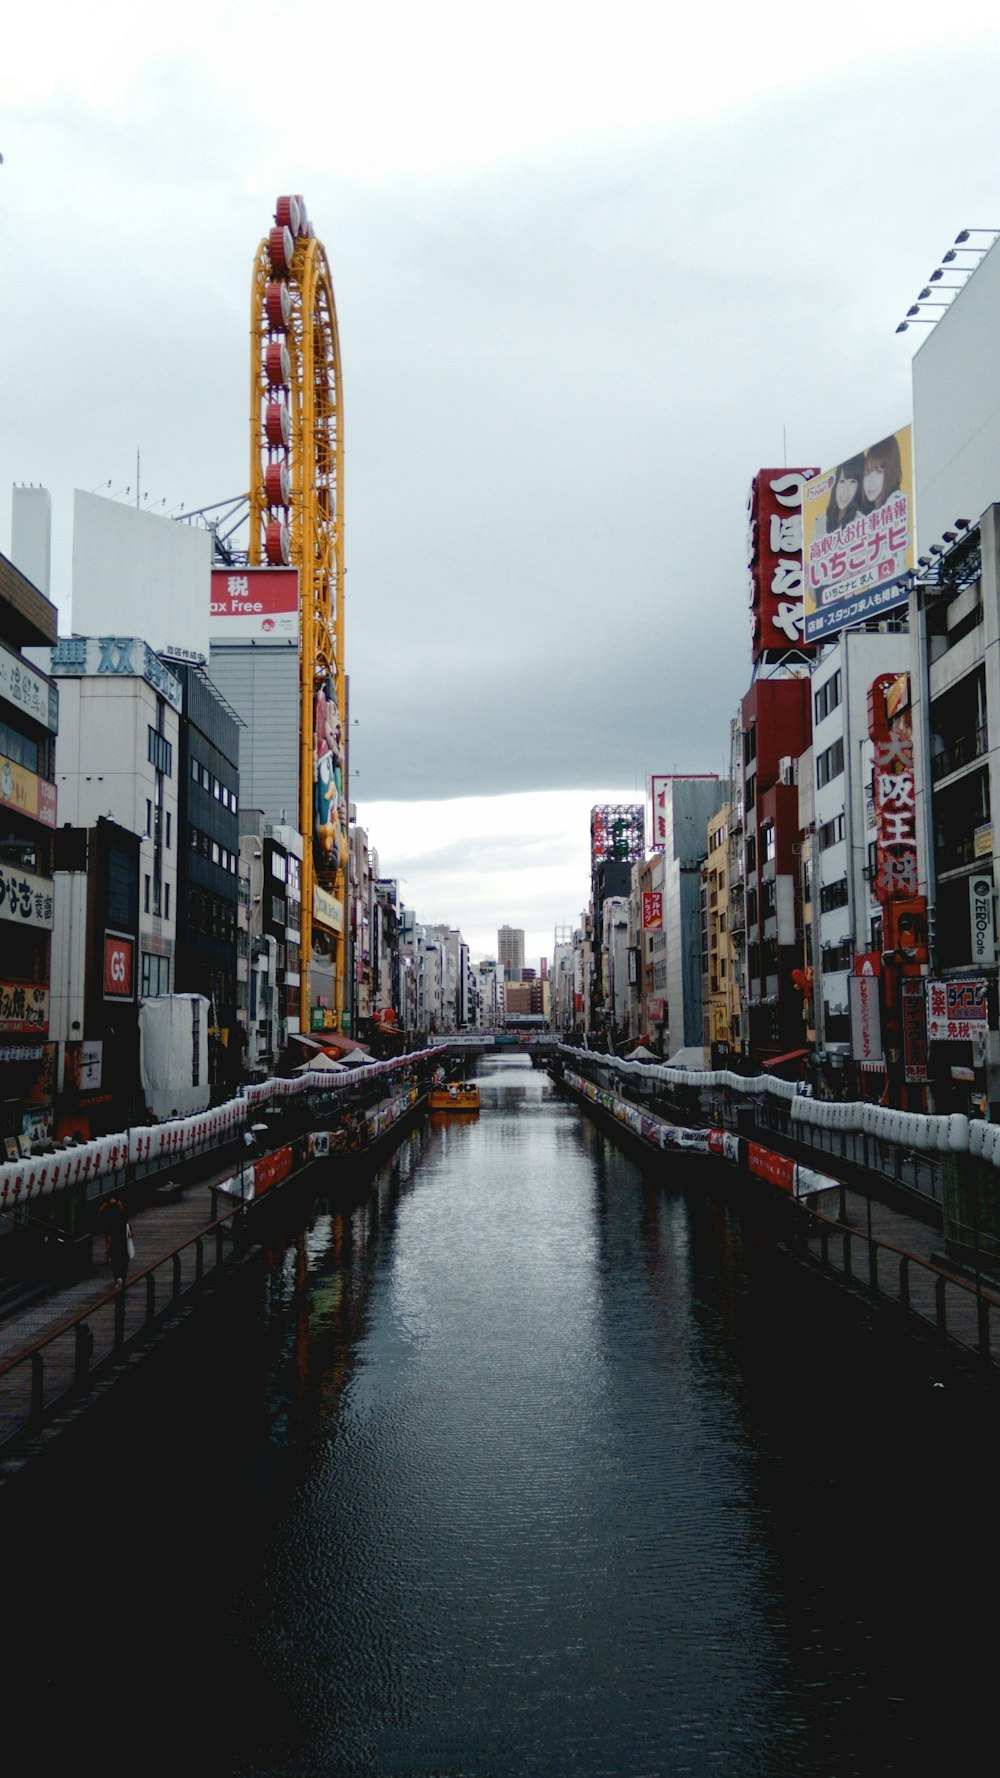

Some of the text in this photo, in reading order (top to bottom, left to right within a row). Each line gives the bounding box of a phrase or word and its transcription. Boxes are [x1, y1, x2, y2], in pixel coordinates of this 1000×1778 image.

[810, 498, 907, 560] 高収入お仕事情報
[811, 517, 907, 586] いちごナビ
[228, 576, 249, 597] 税
[824, 571, 874, 600] いちごナビ 求人
[231, 600, 263, 612] Free
[873, 733, 917, 893] 大阪王将
[652, 893, 661, 917] ツルハ
[111, 950, 126, 982] G3
[931, 984, 946, 1017] 薬
[948, 1021, 970, 1038] 免税
